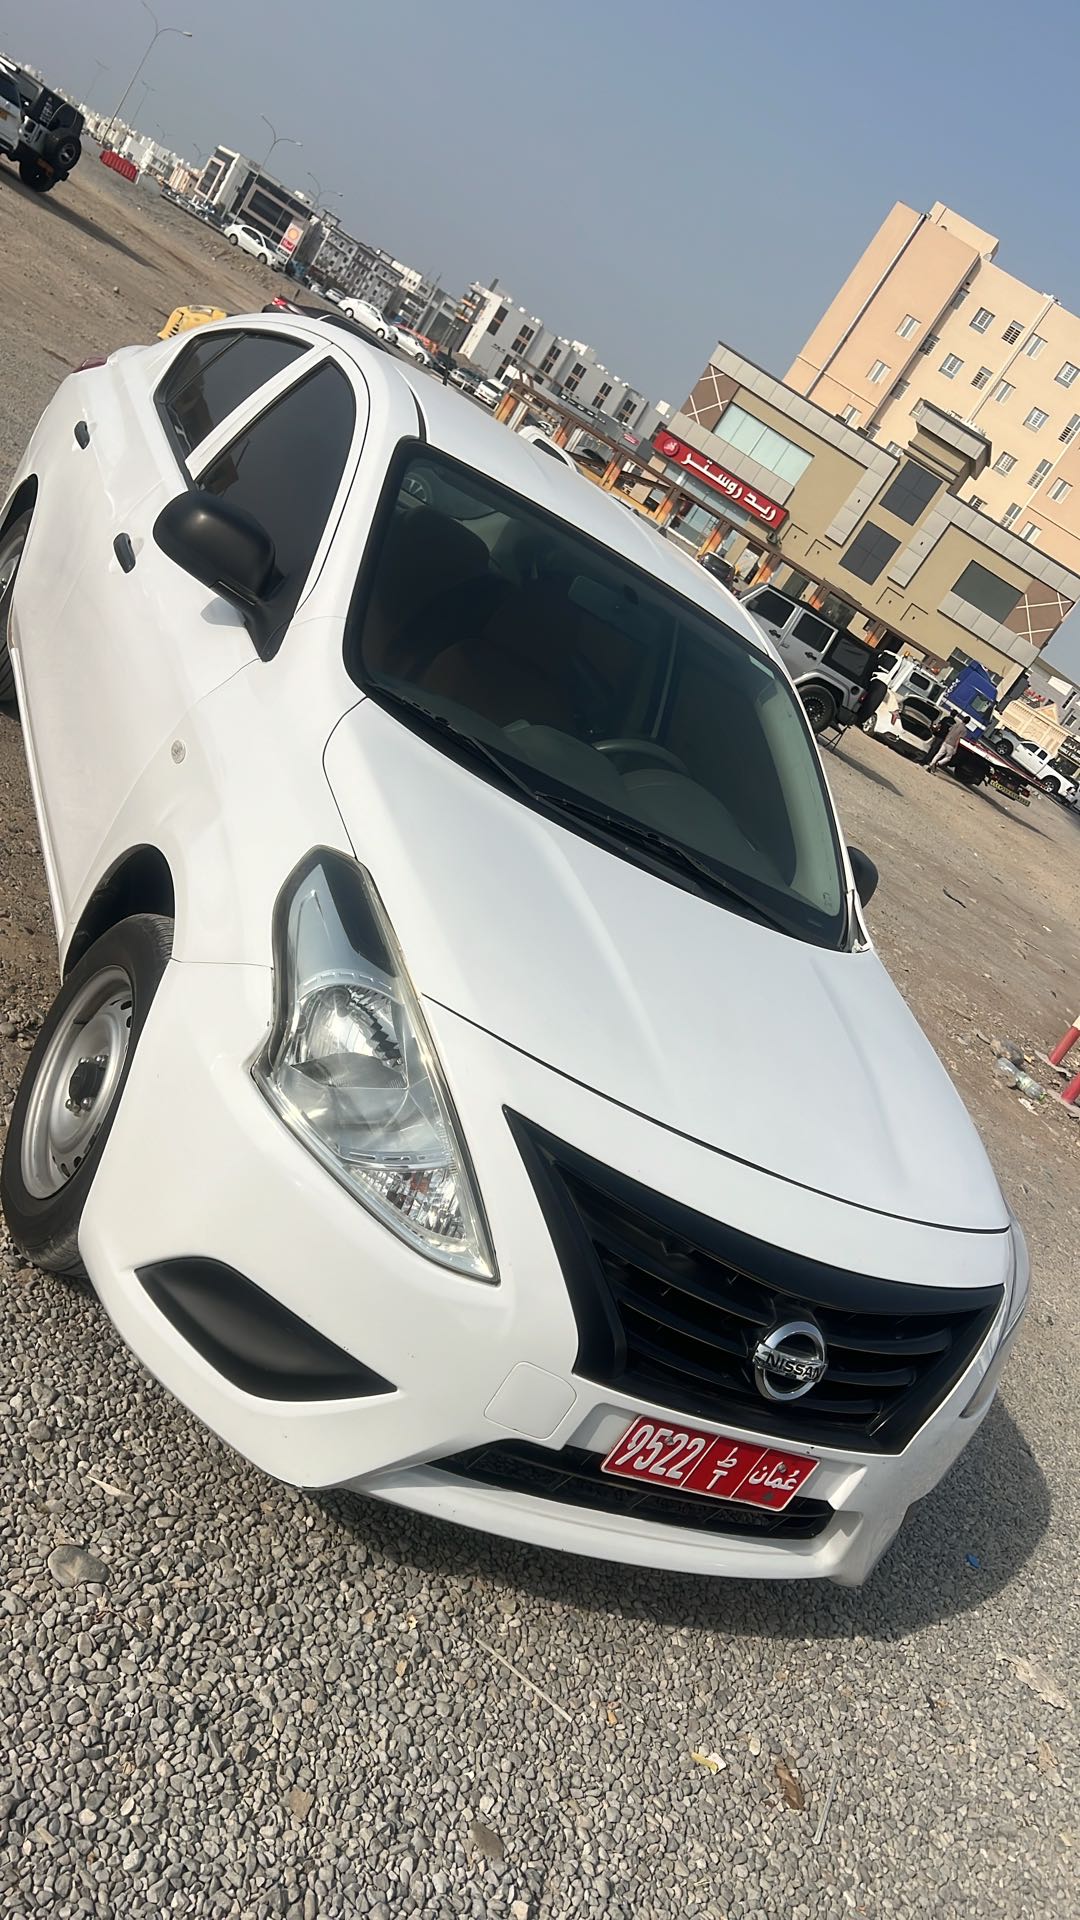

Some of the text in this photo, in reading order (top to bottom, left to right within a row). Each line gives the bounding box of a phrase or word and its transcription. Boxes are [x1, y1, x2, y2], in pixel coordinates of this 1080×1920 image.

[681, 453, 777, 522] ريد روستر
[766, 1352, 821, 1380] NISSAN
[615, 1424, 706, 1480] 9522
[716, 1446, 738, 1467] ط
[706, 1469, 728, 1490] T
